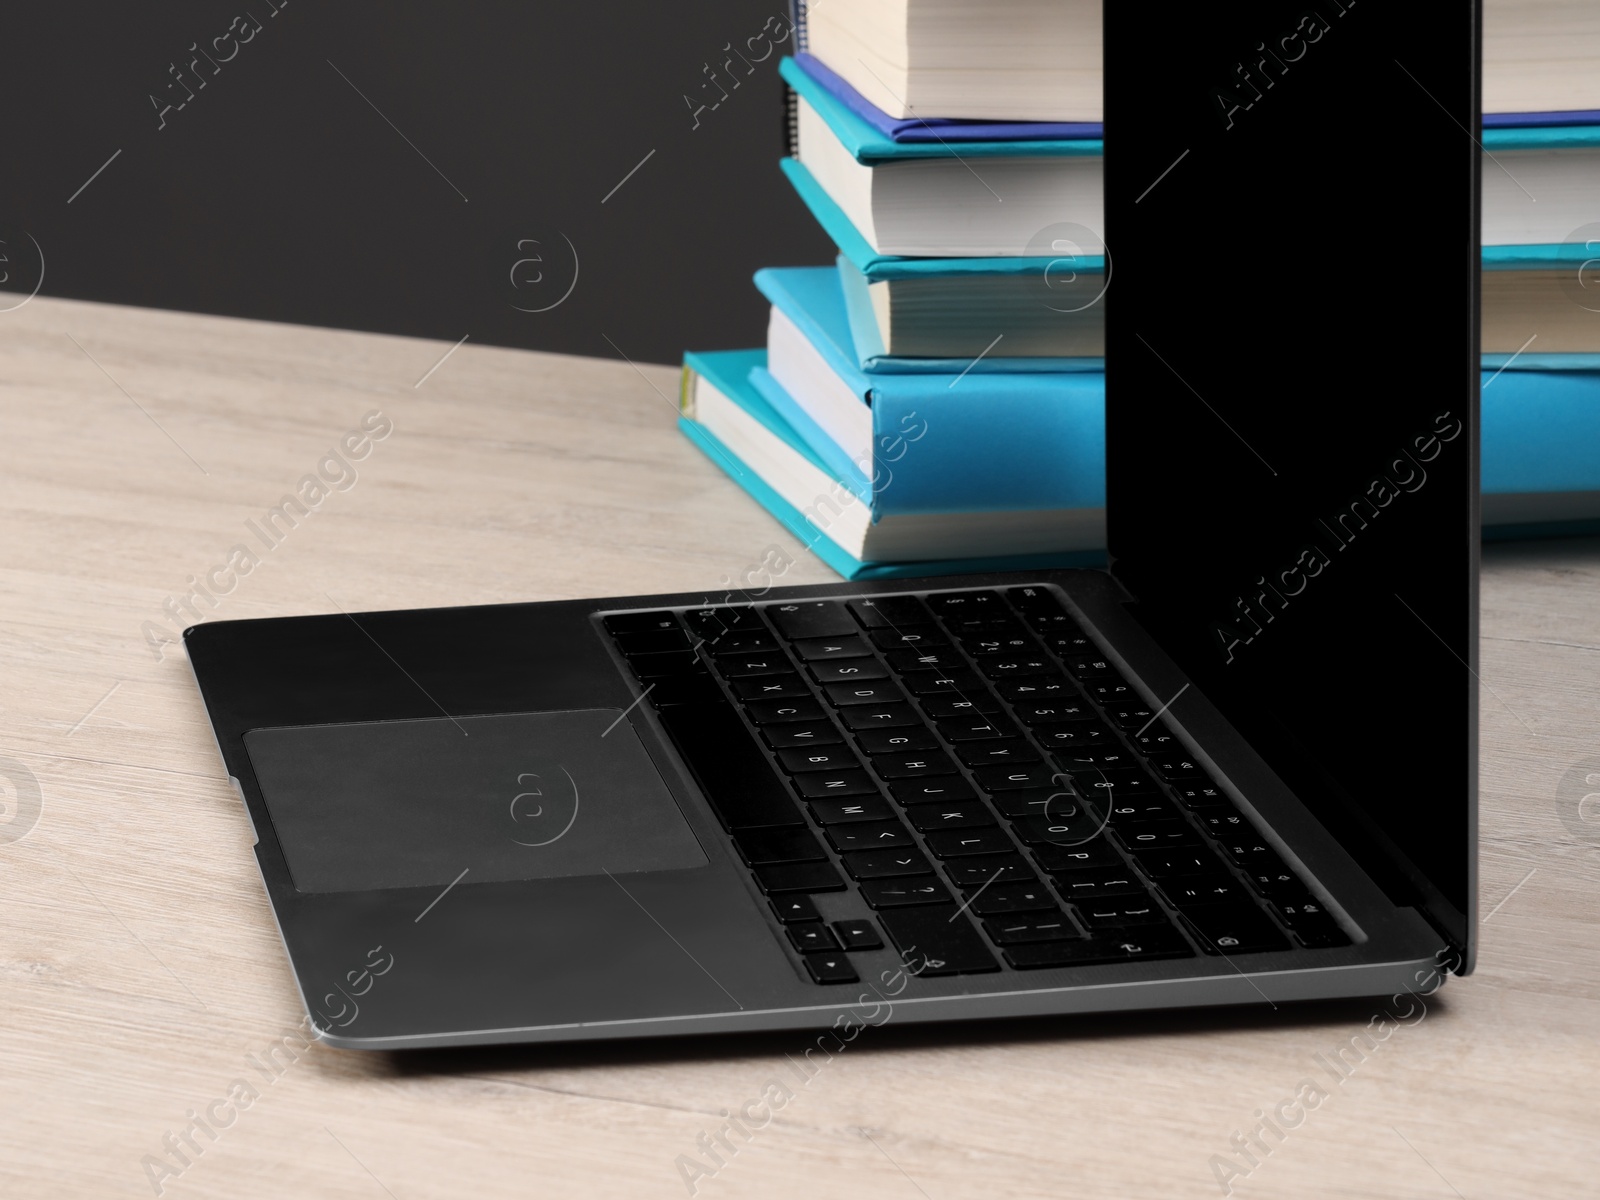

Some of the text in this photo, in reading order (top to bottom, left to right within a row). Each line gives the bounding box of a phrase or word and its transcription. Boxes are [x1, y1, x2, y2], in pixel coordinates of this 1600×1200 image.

[918, 655, 939, 663] W
[905, 761, 926, 769] H
[824, 780, 846, 788] N
[841, 806, 864, 814] M
[1047, 825, 1068, 833] O
